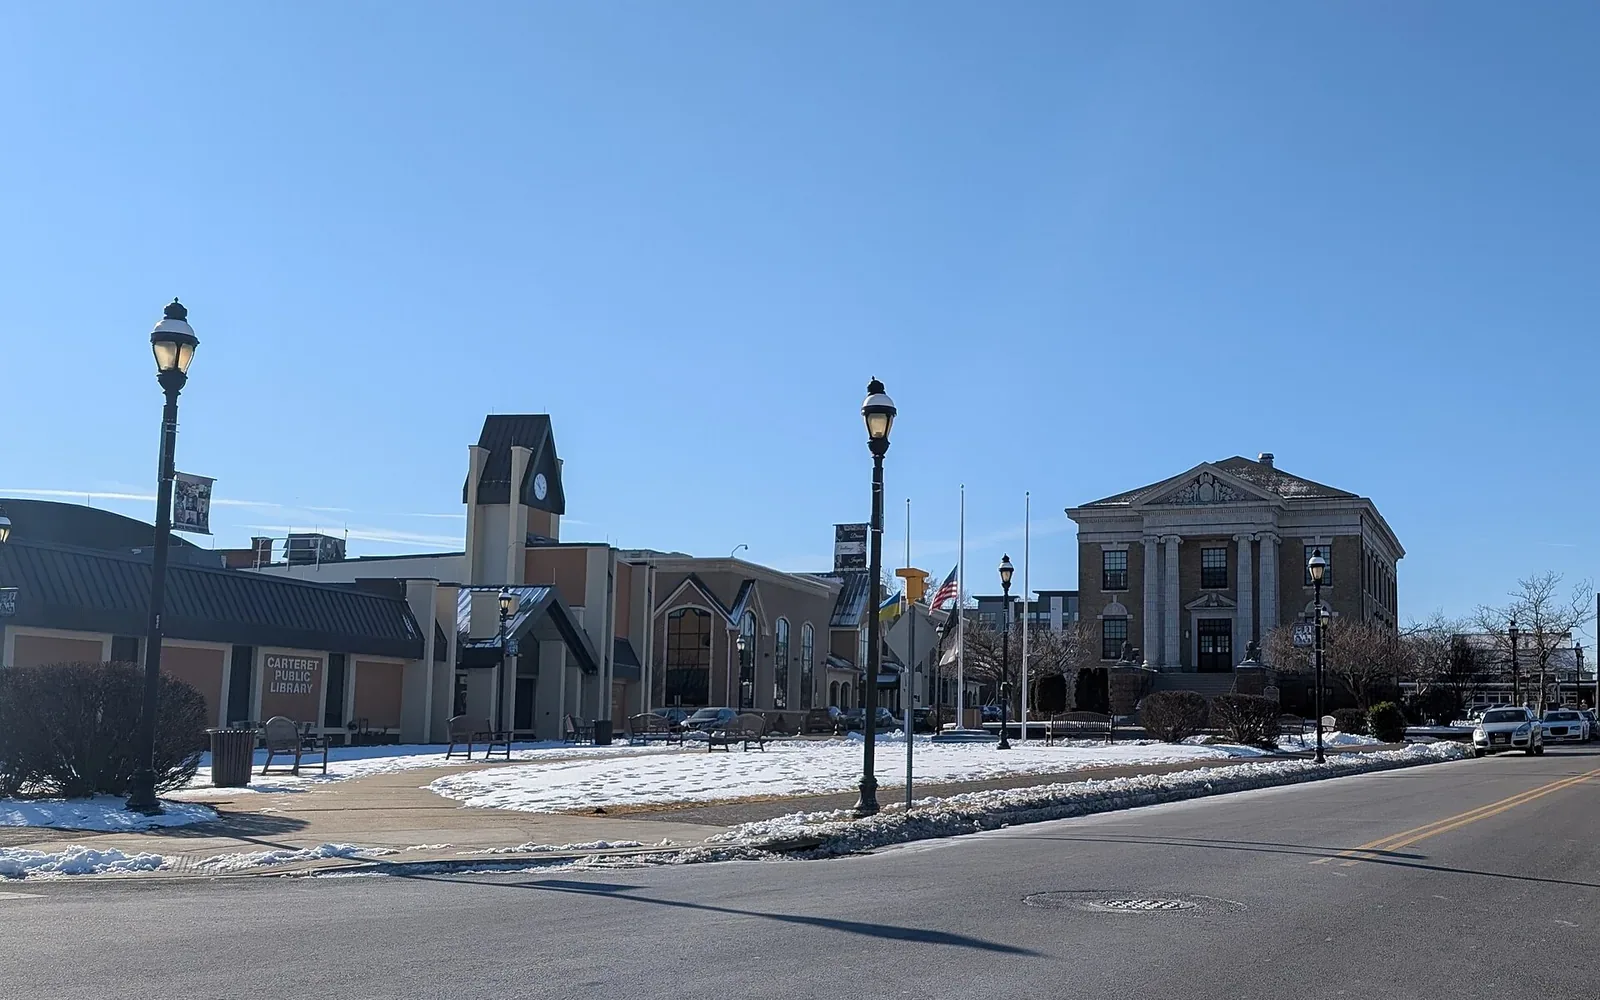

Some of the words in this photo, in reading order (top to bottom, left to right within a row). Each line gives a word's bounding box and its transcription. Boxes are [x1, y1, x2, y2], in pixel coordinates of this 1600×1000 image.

[267, 657, 319, 671] CARTERET
[275, 669, 311, 682] PUBLIC
[270, 682, 313, 694] LIBRARY
